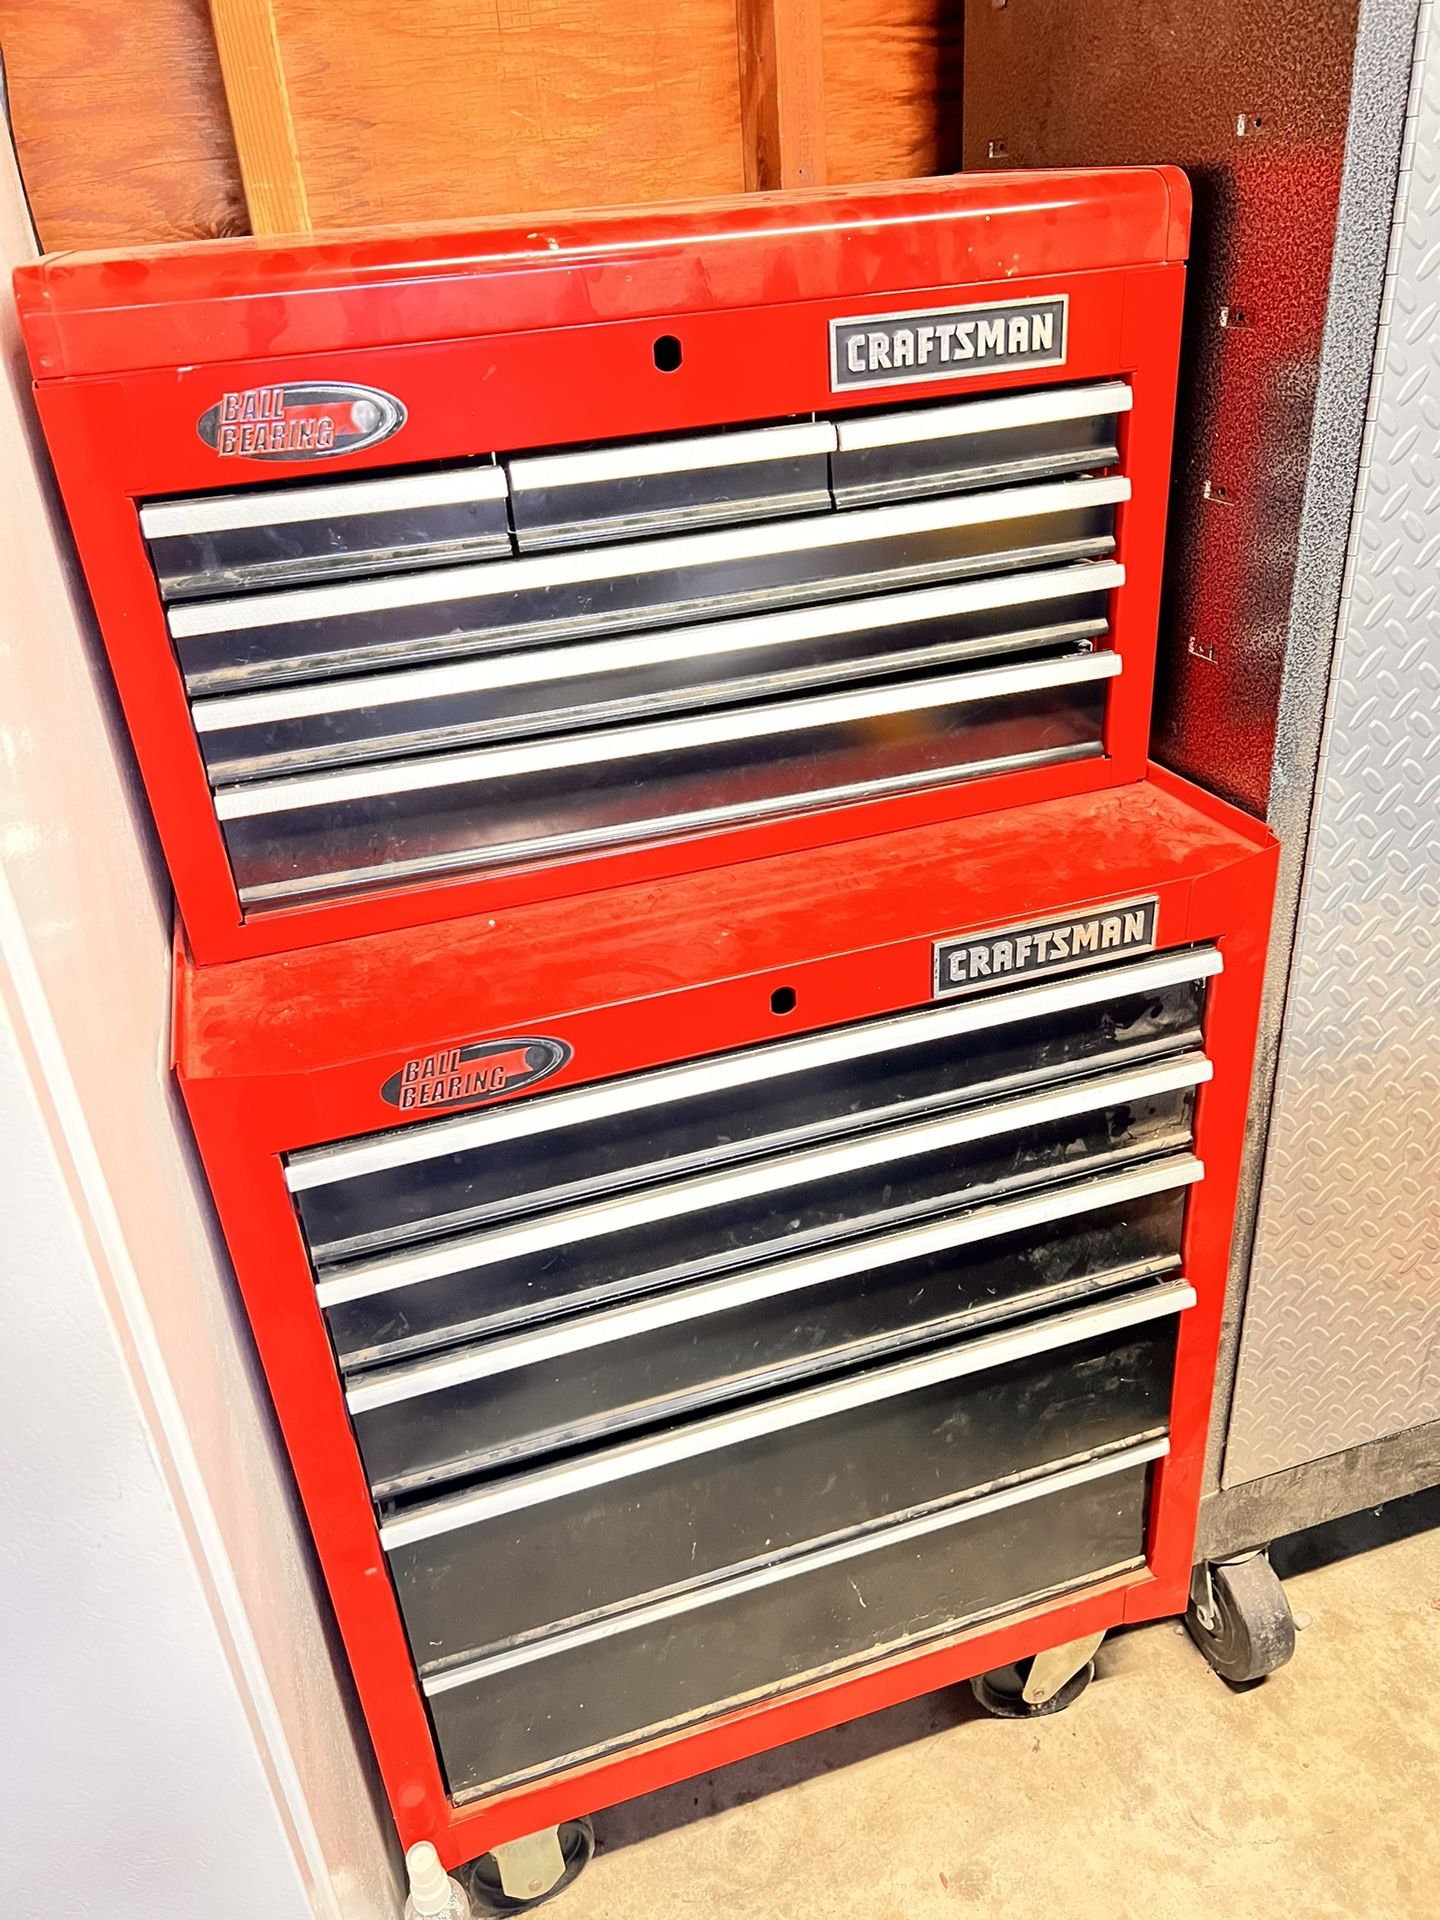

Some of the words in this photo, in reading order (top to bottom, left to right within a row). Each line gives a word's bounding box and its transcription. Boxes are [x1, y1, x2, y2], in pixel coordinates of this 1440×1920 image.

[847, 313, 1054, 372] CRAFTSMAN
[222, 389, 285, 423] BALL
[219, 417, 335, 456] BEARING
[949, 910, 1145, 982] CRAFTSMAN
[402, 1049, 461, 1084] BALL
[400, 1067, 506, 1110] BEARING
